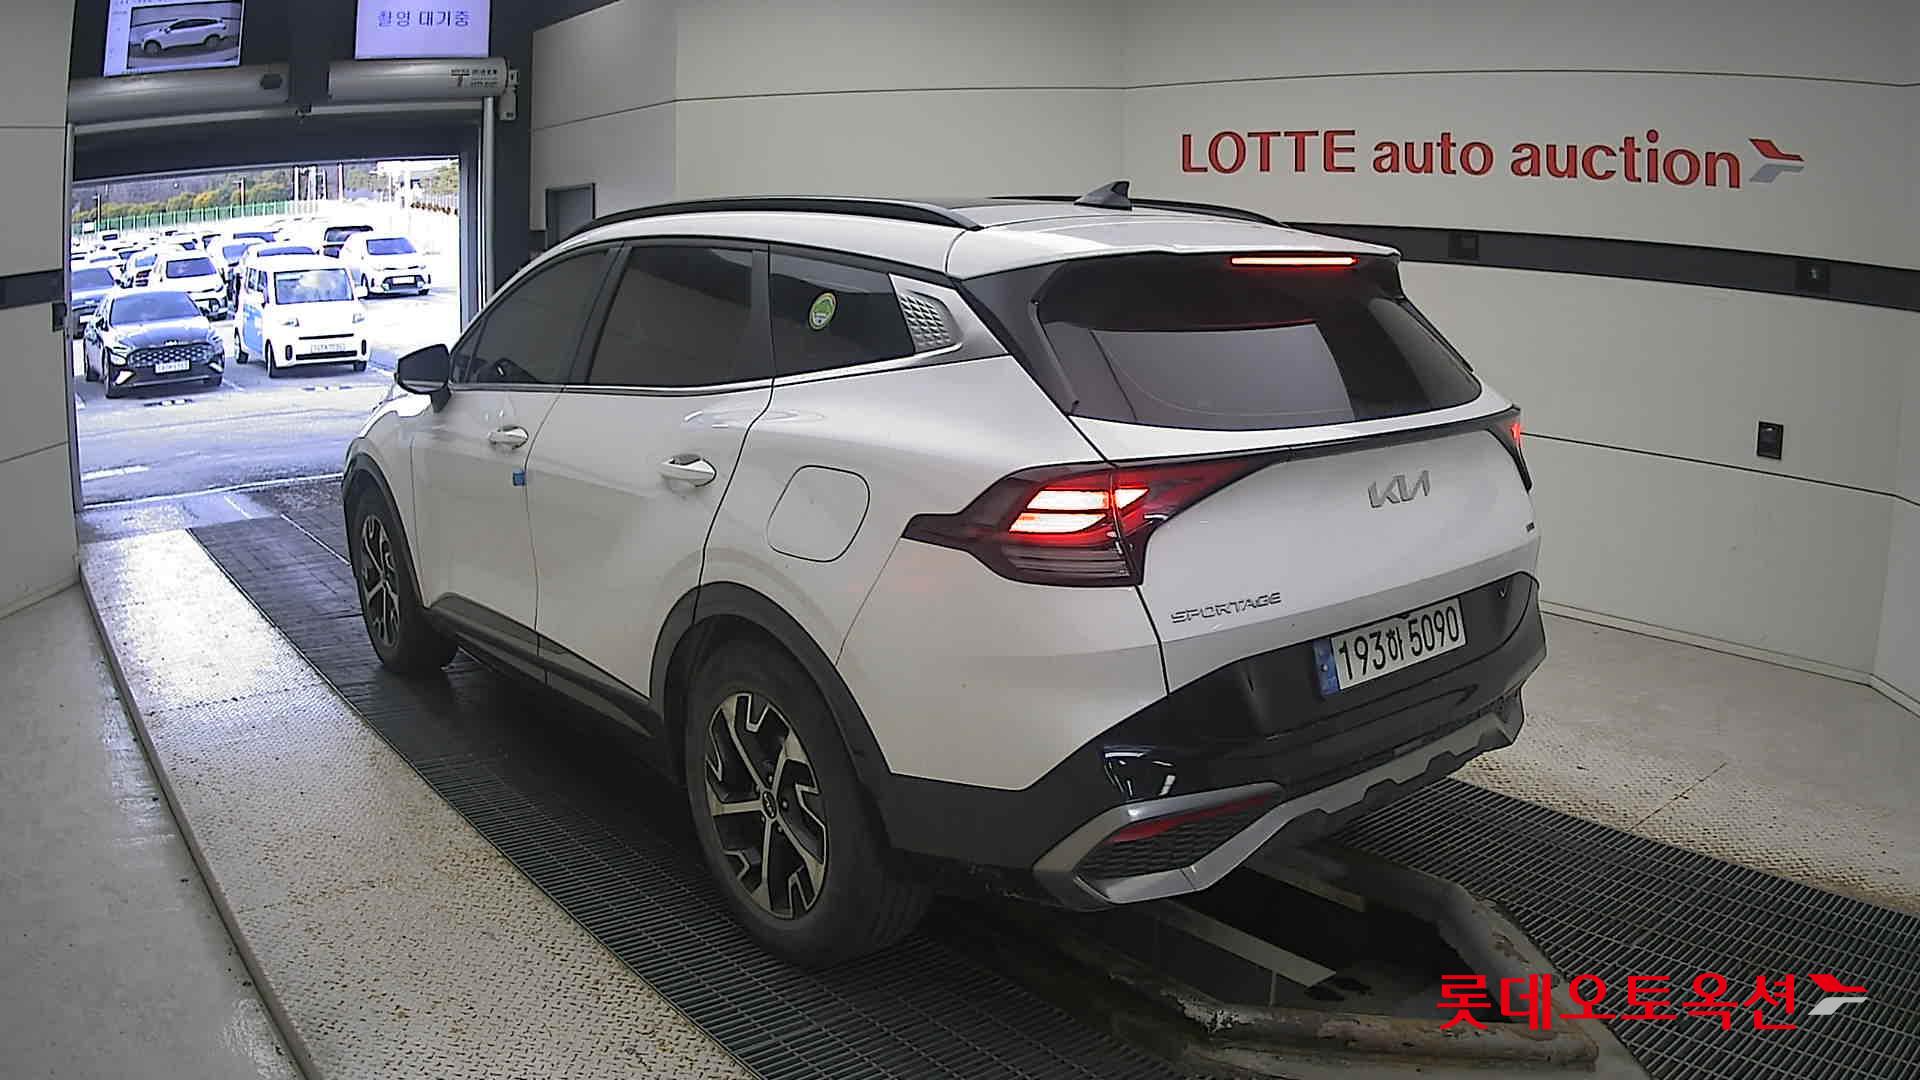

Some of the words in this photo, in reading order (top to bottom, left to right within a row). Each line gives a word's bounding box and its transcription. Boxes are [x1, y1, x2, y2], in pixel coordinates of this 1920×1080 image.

[1181, 130, 1357, 175] LOTTE
[1371, 131, 1495, 177] auto
[1511, 128, 1742, 190] auction
[1170, 592, 1282, 624] SPORTAGE
